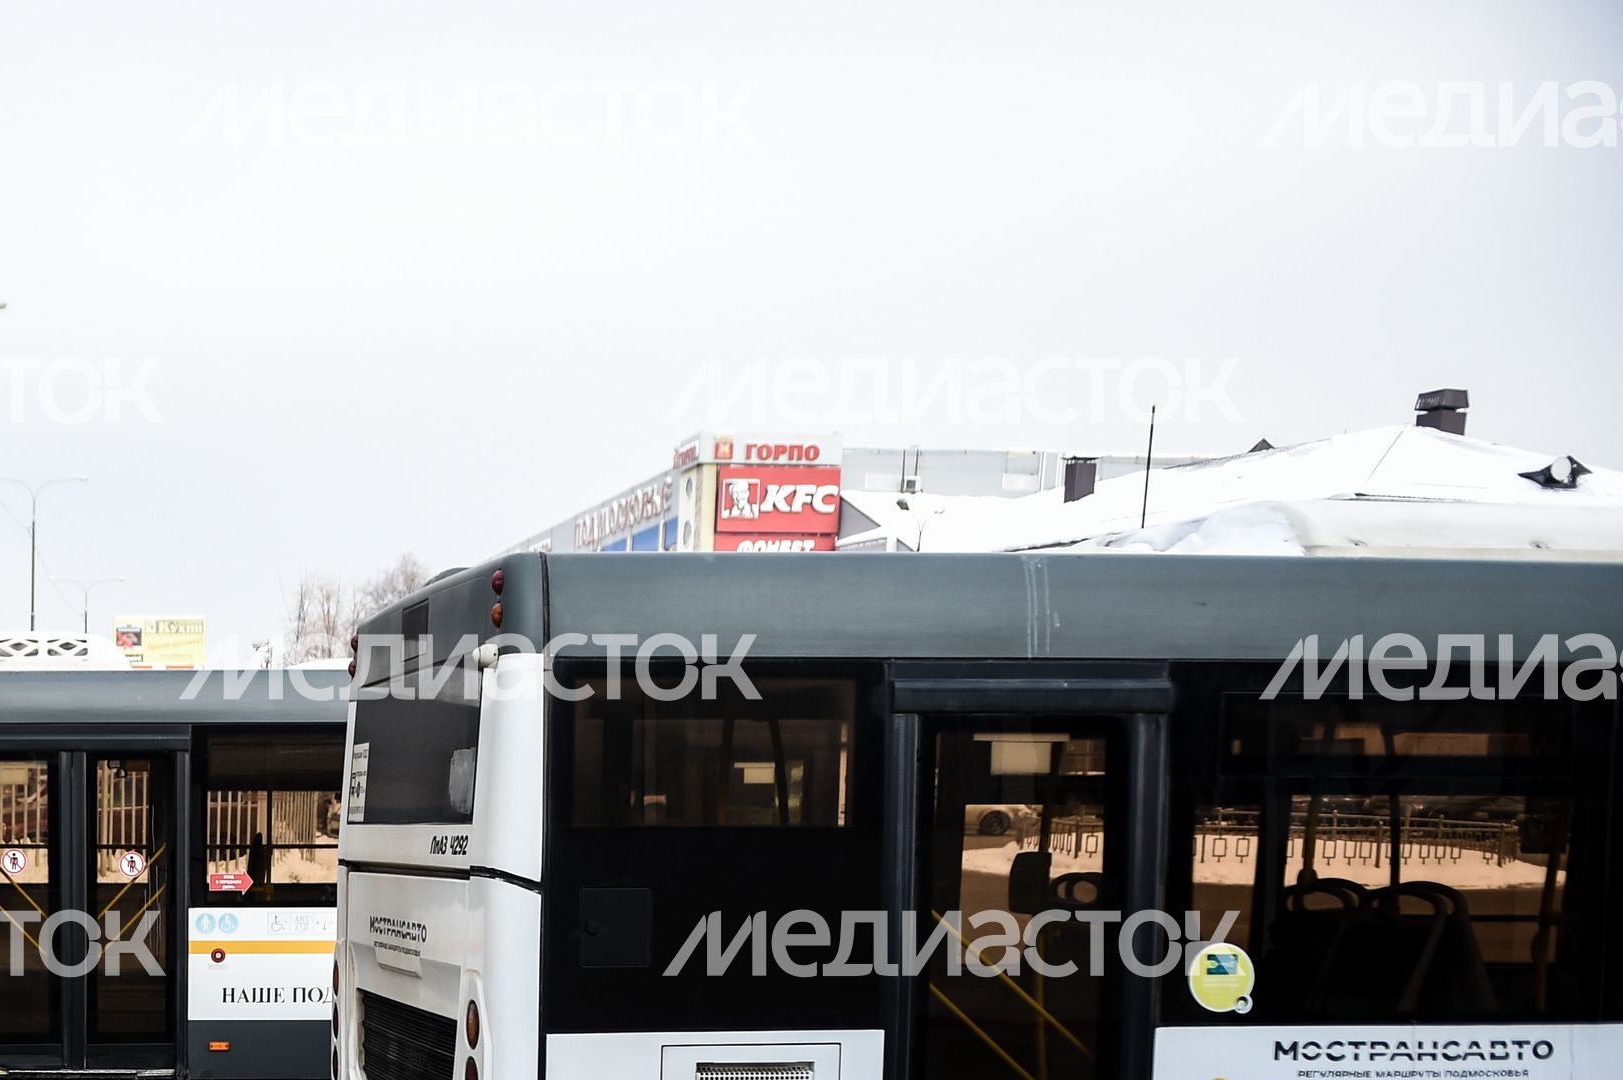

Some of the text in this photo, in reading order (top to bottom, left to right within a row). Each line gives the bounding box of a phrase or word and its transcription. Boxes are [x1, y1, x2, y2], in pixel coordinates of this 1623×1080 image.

[746, 443, 821, 461] ГОРПО
[760, 484, 840, 513] KFC
[450, 835, 469, 855] 4292
[370, 916, 427, 943] МОСТРАНСАВТО
[222, 987, 285, 1003] НАШЕ
[1274, 1040, 1555, 1062] МОСТРАНСАВТО
[1298, 1069, 1529, 1079] РЕГУЛЯРНЫЕ МАРШРУТЫ ПОДМОСКОВЬЯ
